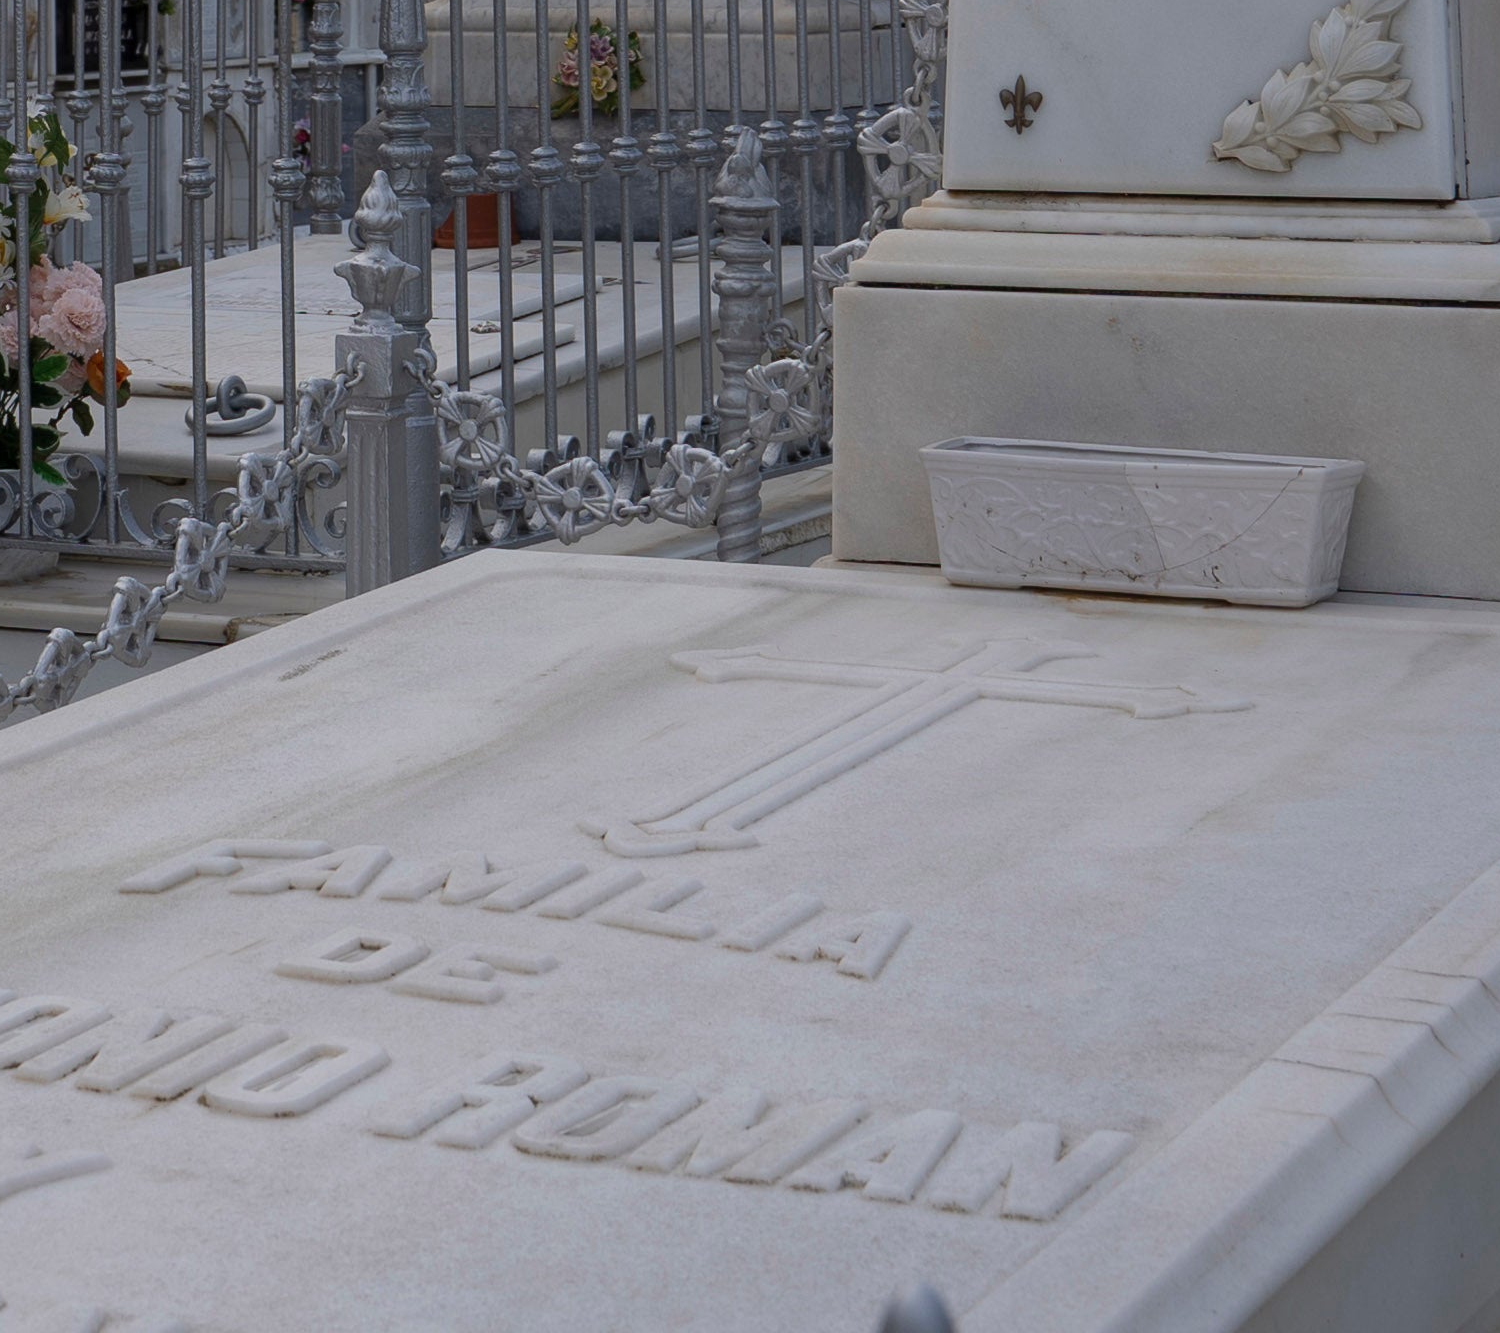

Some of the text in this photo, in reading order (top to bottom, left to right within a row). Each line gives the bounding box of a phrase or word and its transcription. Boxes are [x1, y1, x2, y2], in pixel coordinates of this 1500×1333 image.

[115, 835, 916, 985] FAMILIA
[275, 927, 560, 1003] DE
[366, 1051, 1149, 1224] ROMAN
